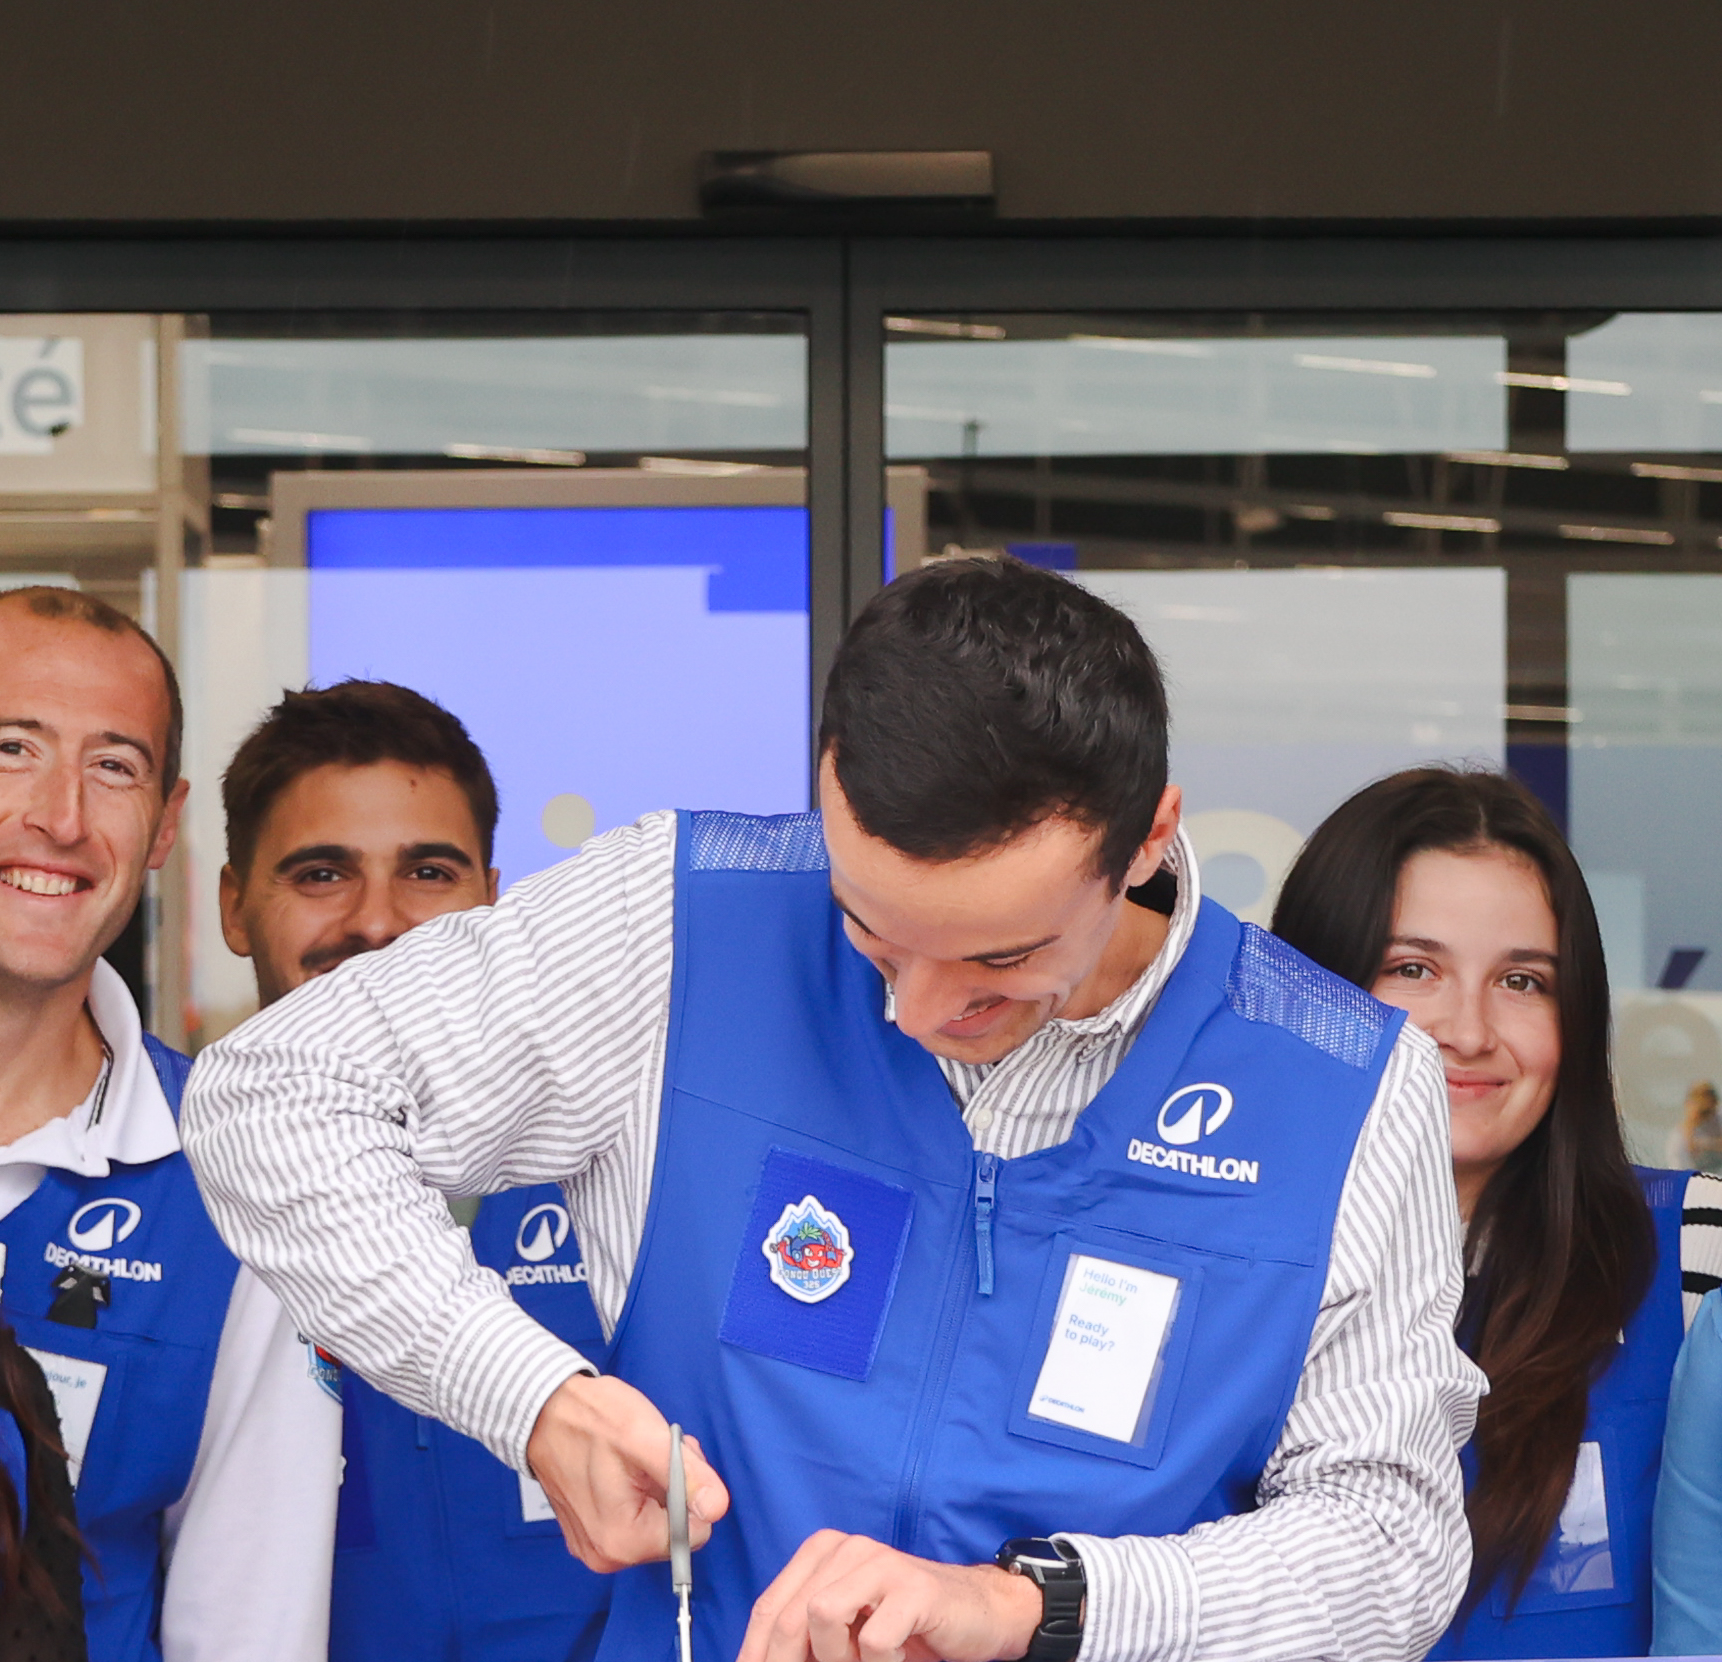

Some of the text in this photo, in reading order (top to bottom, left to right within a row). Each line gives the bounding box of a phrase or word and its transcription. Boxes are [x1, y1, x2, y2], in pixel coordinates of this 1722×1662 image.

[1127, 1138, 1259, 1184] DECATHLON
[1079, 1281, 1127, 1307] Jérémy
[1083, 1268, 1138, 1294] Hello I'm
[1068, 1313, 1109, 1338] Ready
[1064, 1328, 1115, 1352] to play?
